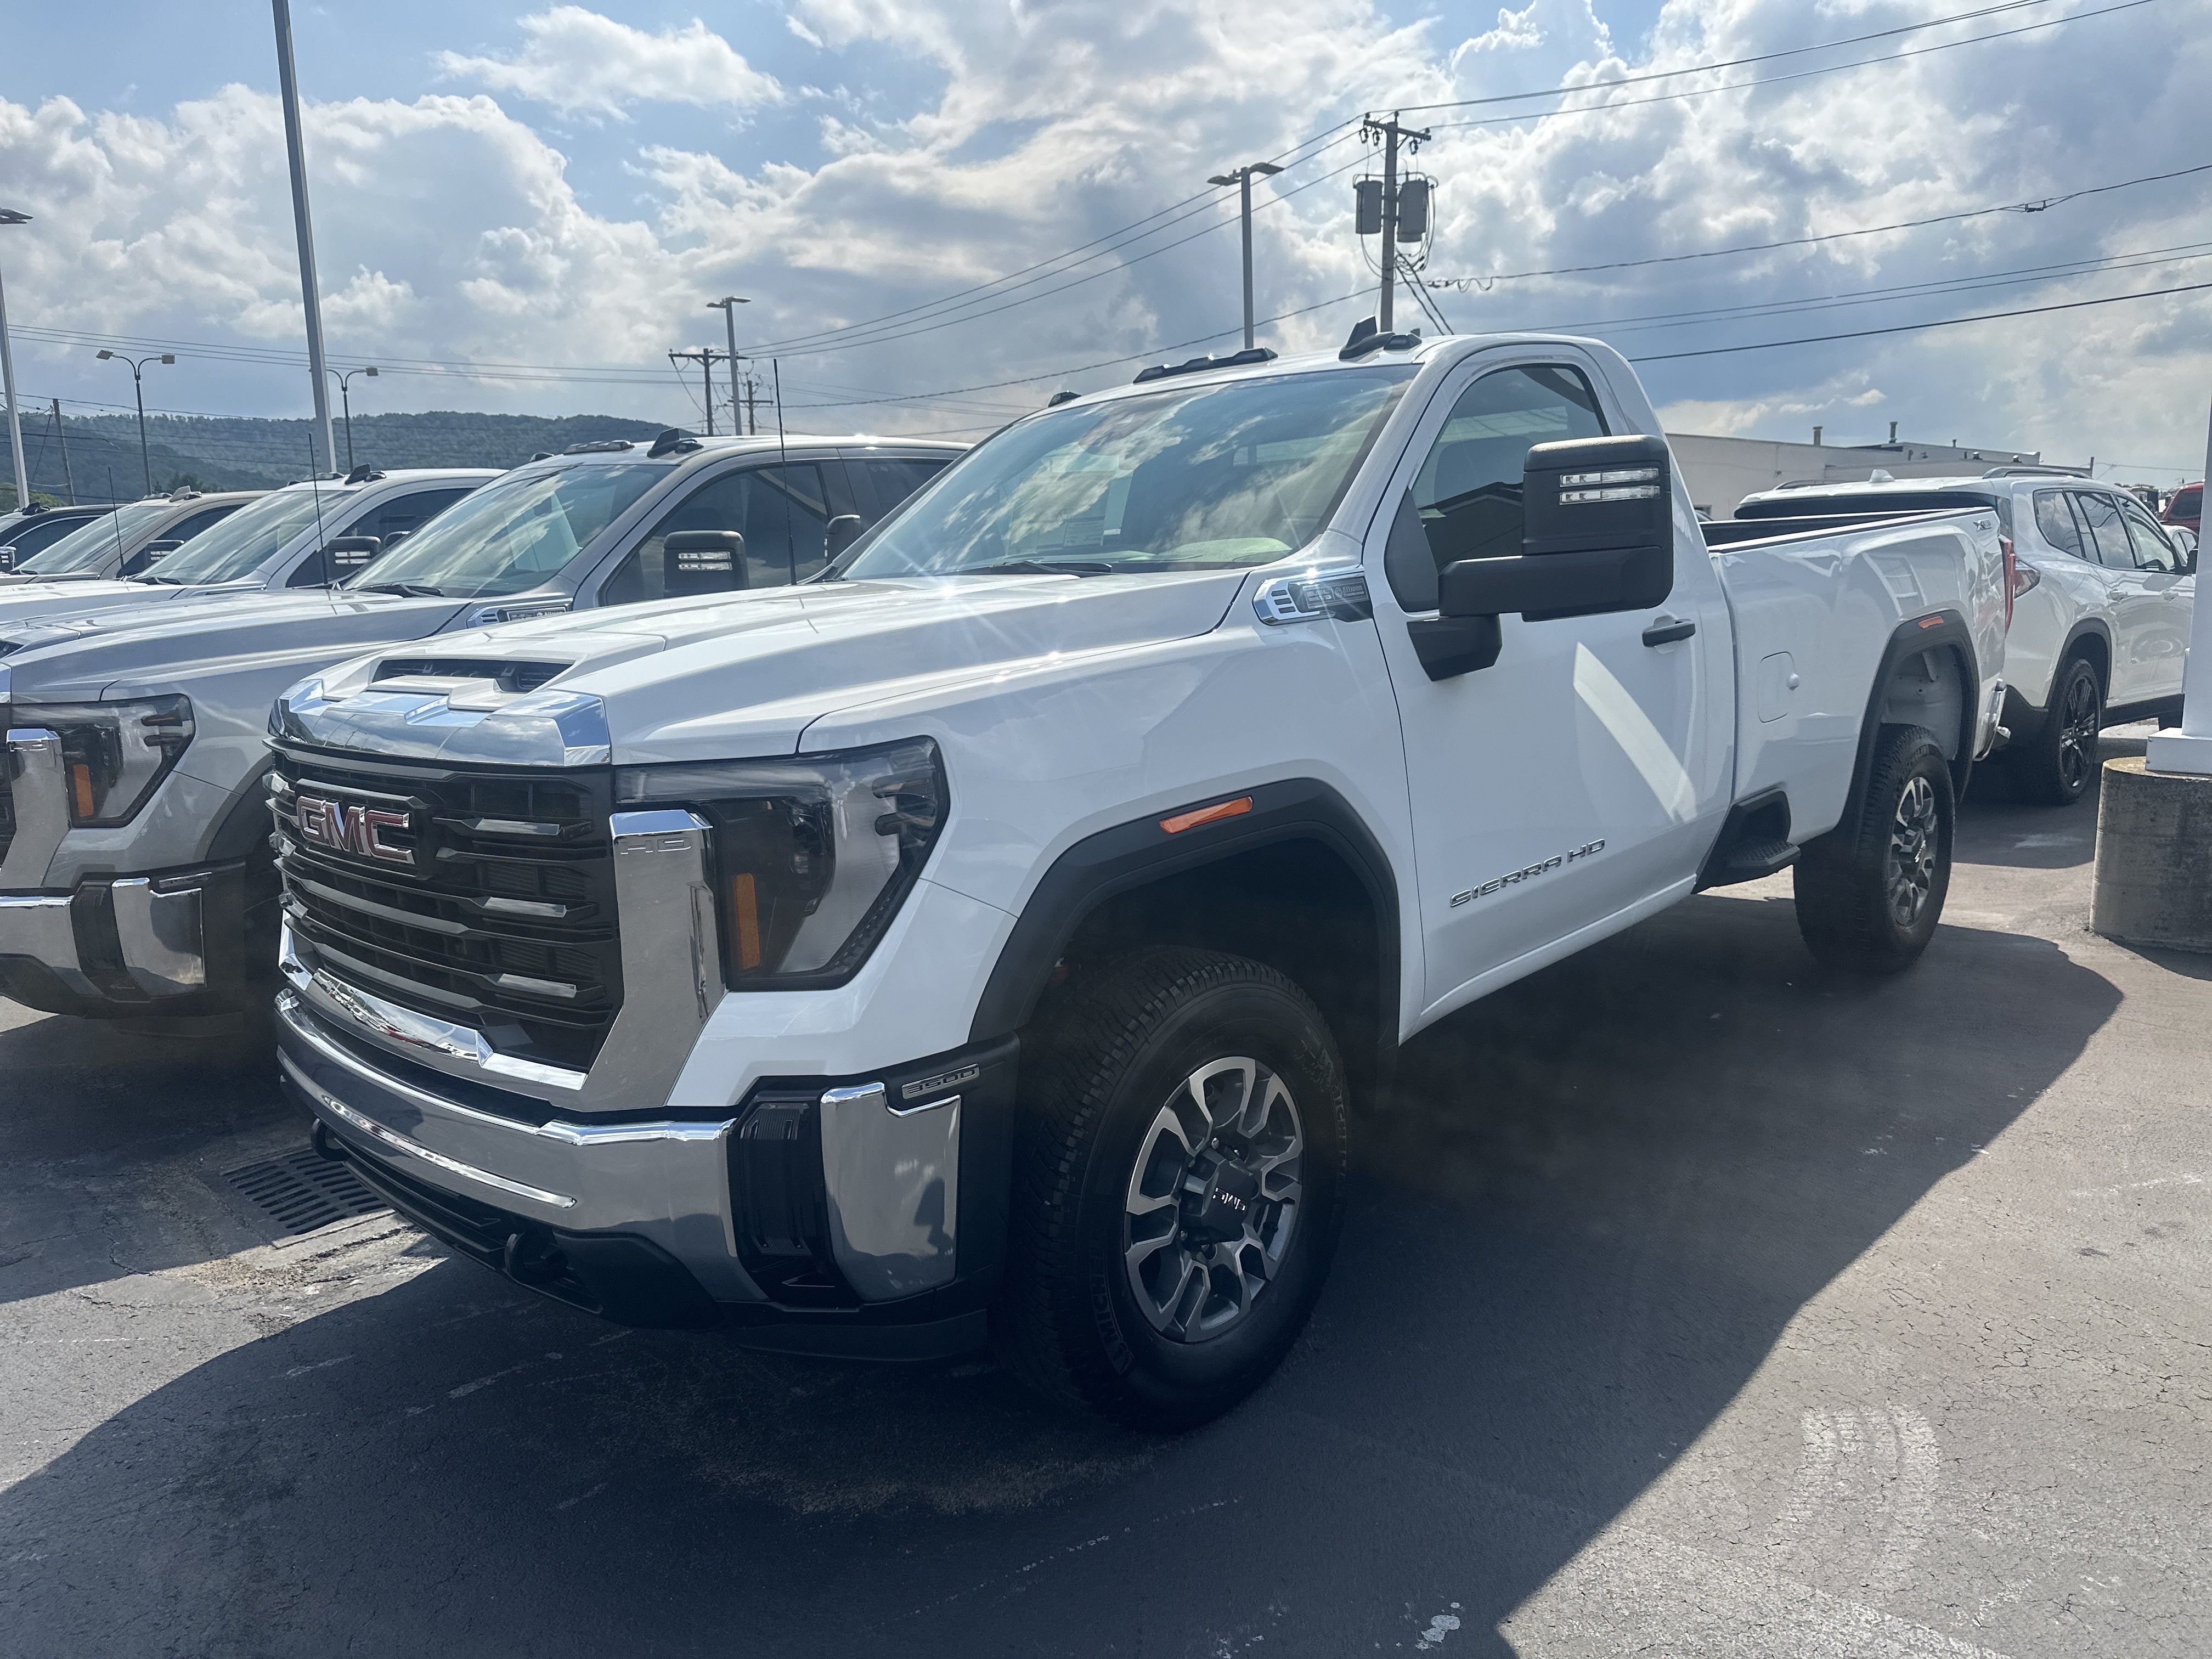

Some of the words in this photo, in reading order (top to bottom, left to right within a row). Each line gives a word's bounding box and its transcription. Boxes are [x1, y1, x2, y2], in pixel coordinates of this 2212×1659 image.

[297, 795, 416, 865] GMC
[1449, 855, 1562, 908] SIERRA
[1567, 838, 1605, 863] HD
[906, 1068, 975, 1094] 3500
